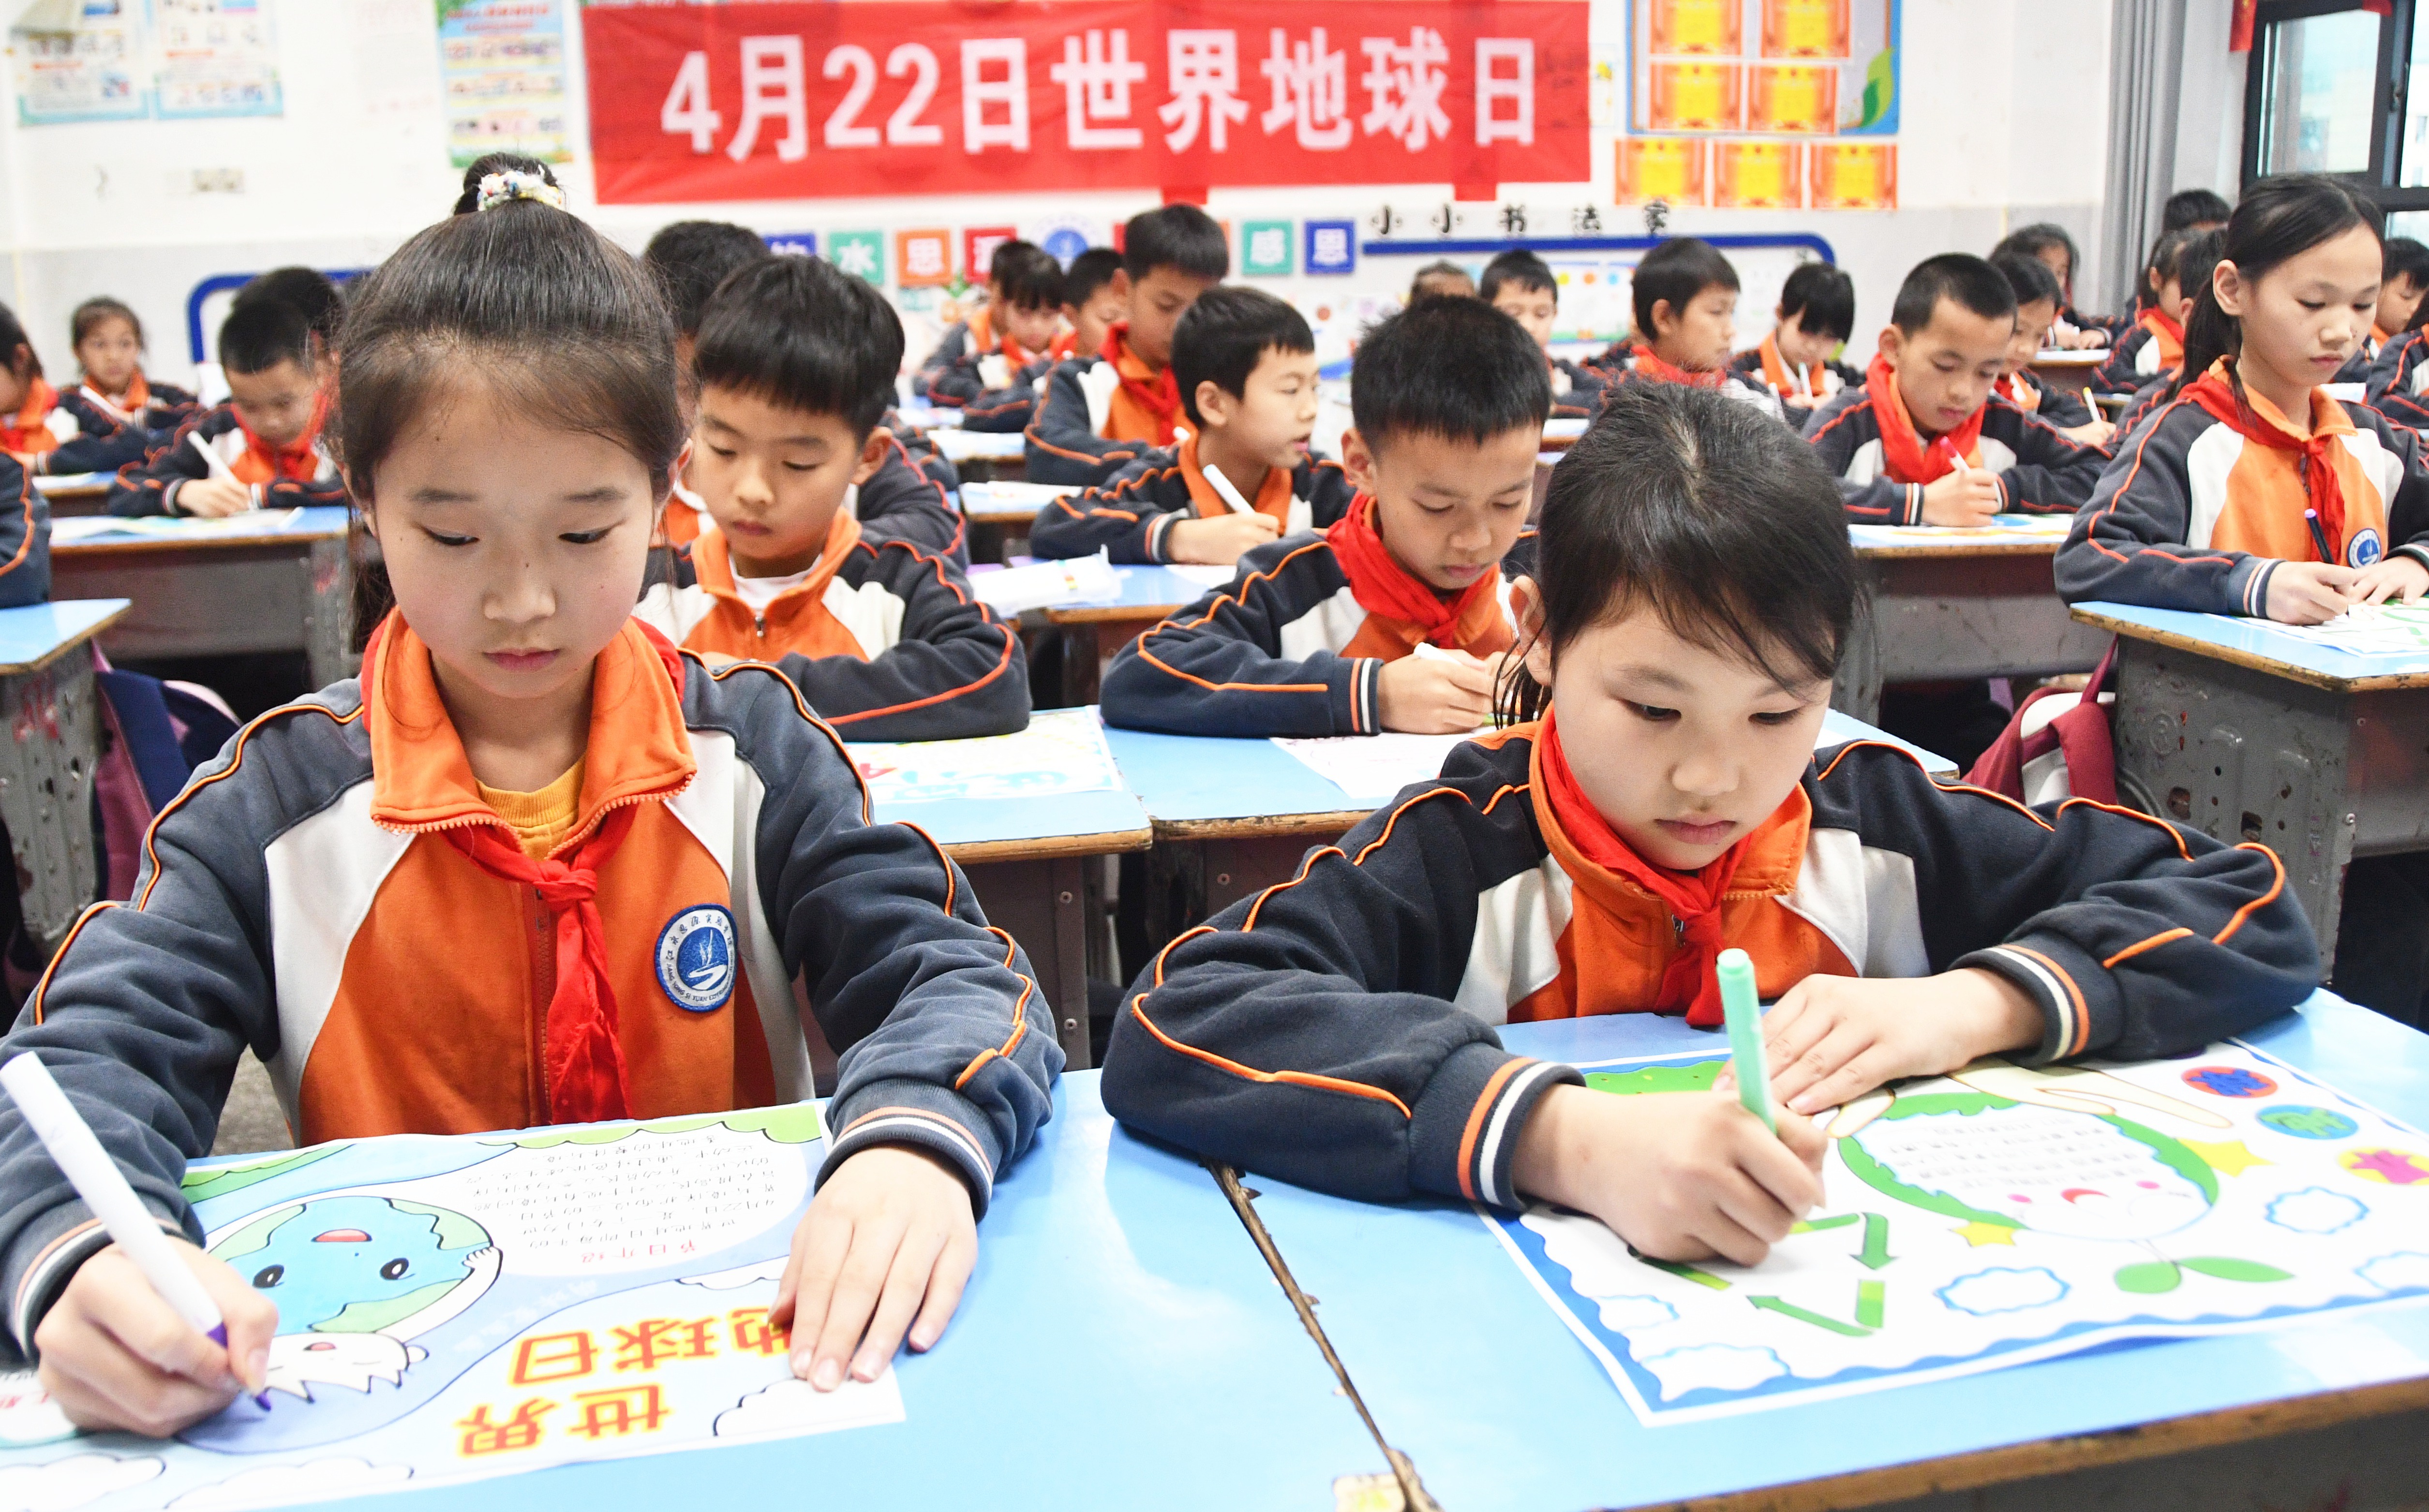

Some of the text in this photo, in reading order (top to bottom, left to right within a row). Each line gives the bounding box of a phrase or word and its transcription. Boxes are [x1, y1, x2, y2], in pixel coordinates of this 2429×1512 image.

[660, 27, 1535, 163] 4月22日世界地球日
[1371, 199, 1669, 237] 小小书法家
[580, 1239, 696, 1263] 节日介绍
[455, 1384, 671, 1457] 世界
